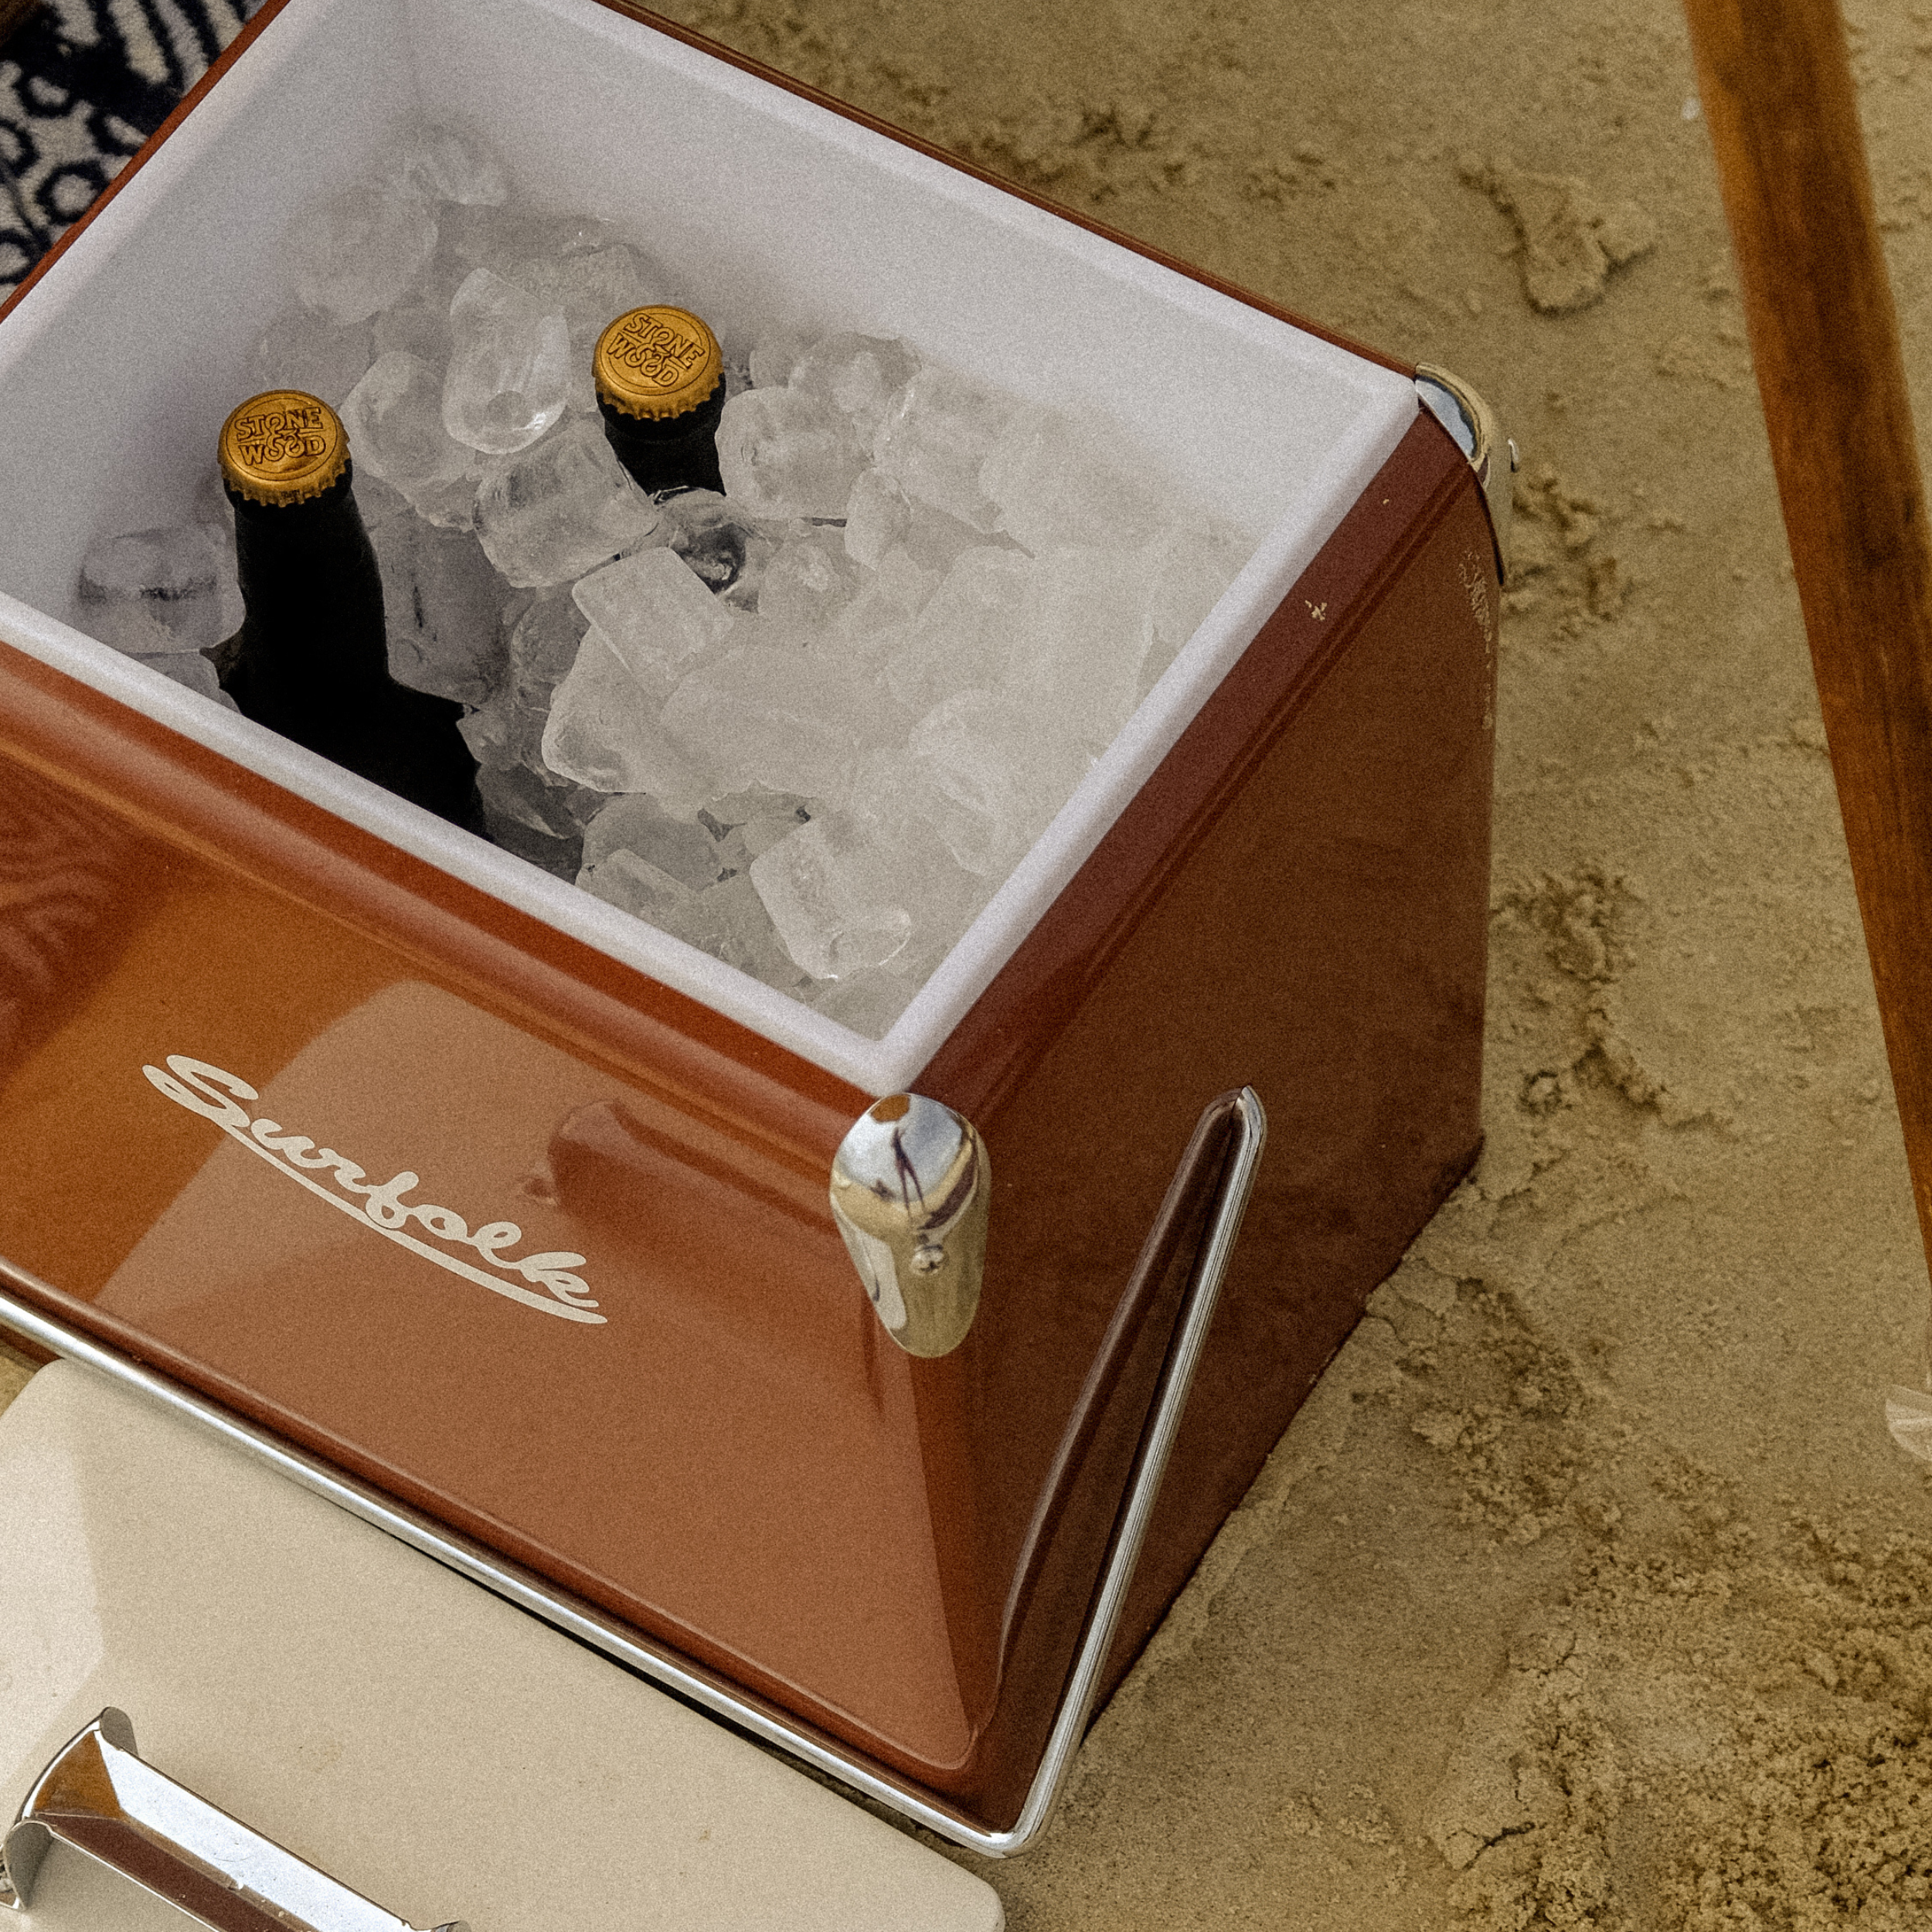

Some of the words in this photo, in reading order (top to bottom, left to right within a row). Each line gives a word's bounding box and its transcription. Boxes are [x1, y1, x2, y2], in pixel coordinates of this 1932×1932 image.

[607, 332, 679, 387] WOOD
[624, 313, 706, 369] STONE
[234, 406, 324, 442] STONE
[238, 435, 326, 466] WOOD
